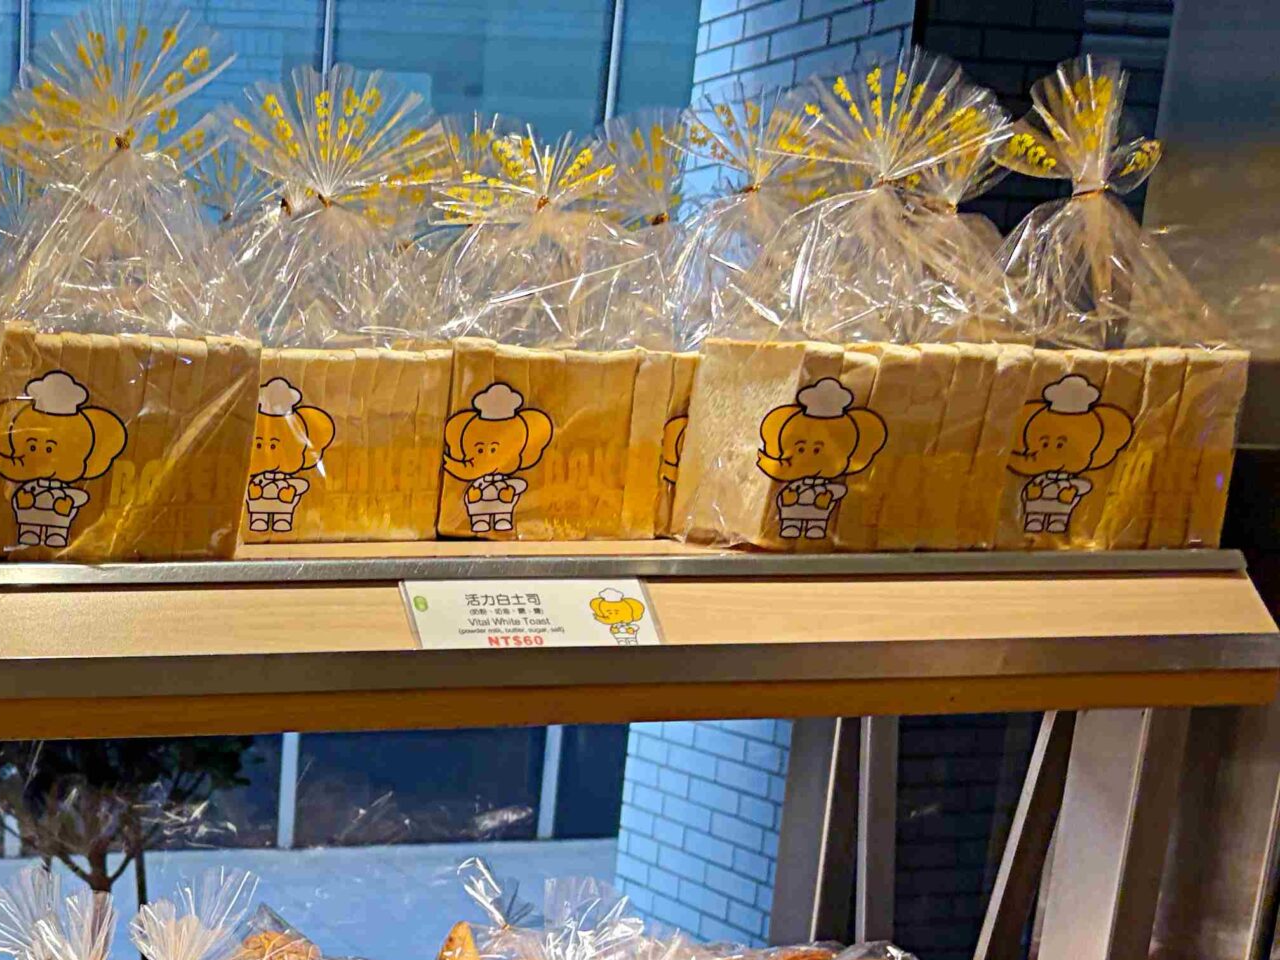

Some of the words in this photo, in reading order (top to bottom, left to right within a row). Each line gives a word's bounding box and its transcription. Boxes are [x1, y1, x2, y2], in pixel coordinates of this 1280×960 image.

[465, 593, 541, 606] 活力白土司
[468, 618, 490, 627] Vital
[492, 617, 521, 626] White
[523, 617, 551, 626] Toast
[488, 635, 544, 646] NT$60
